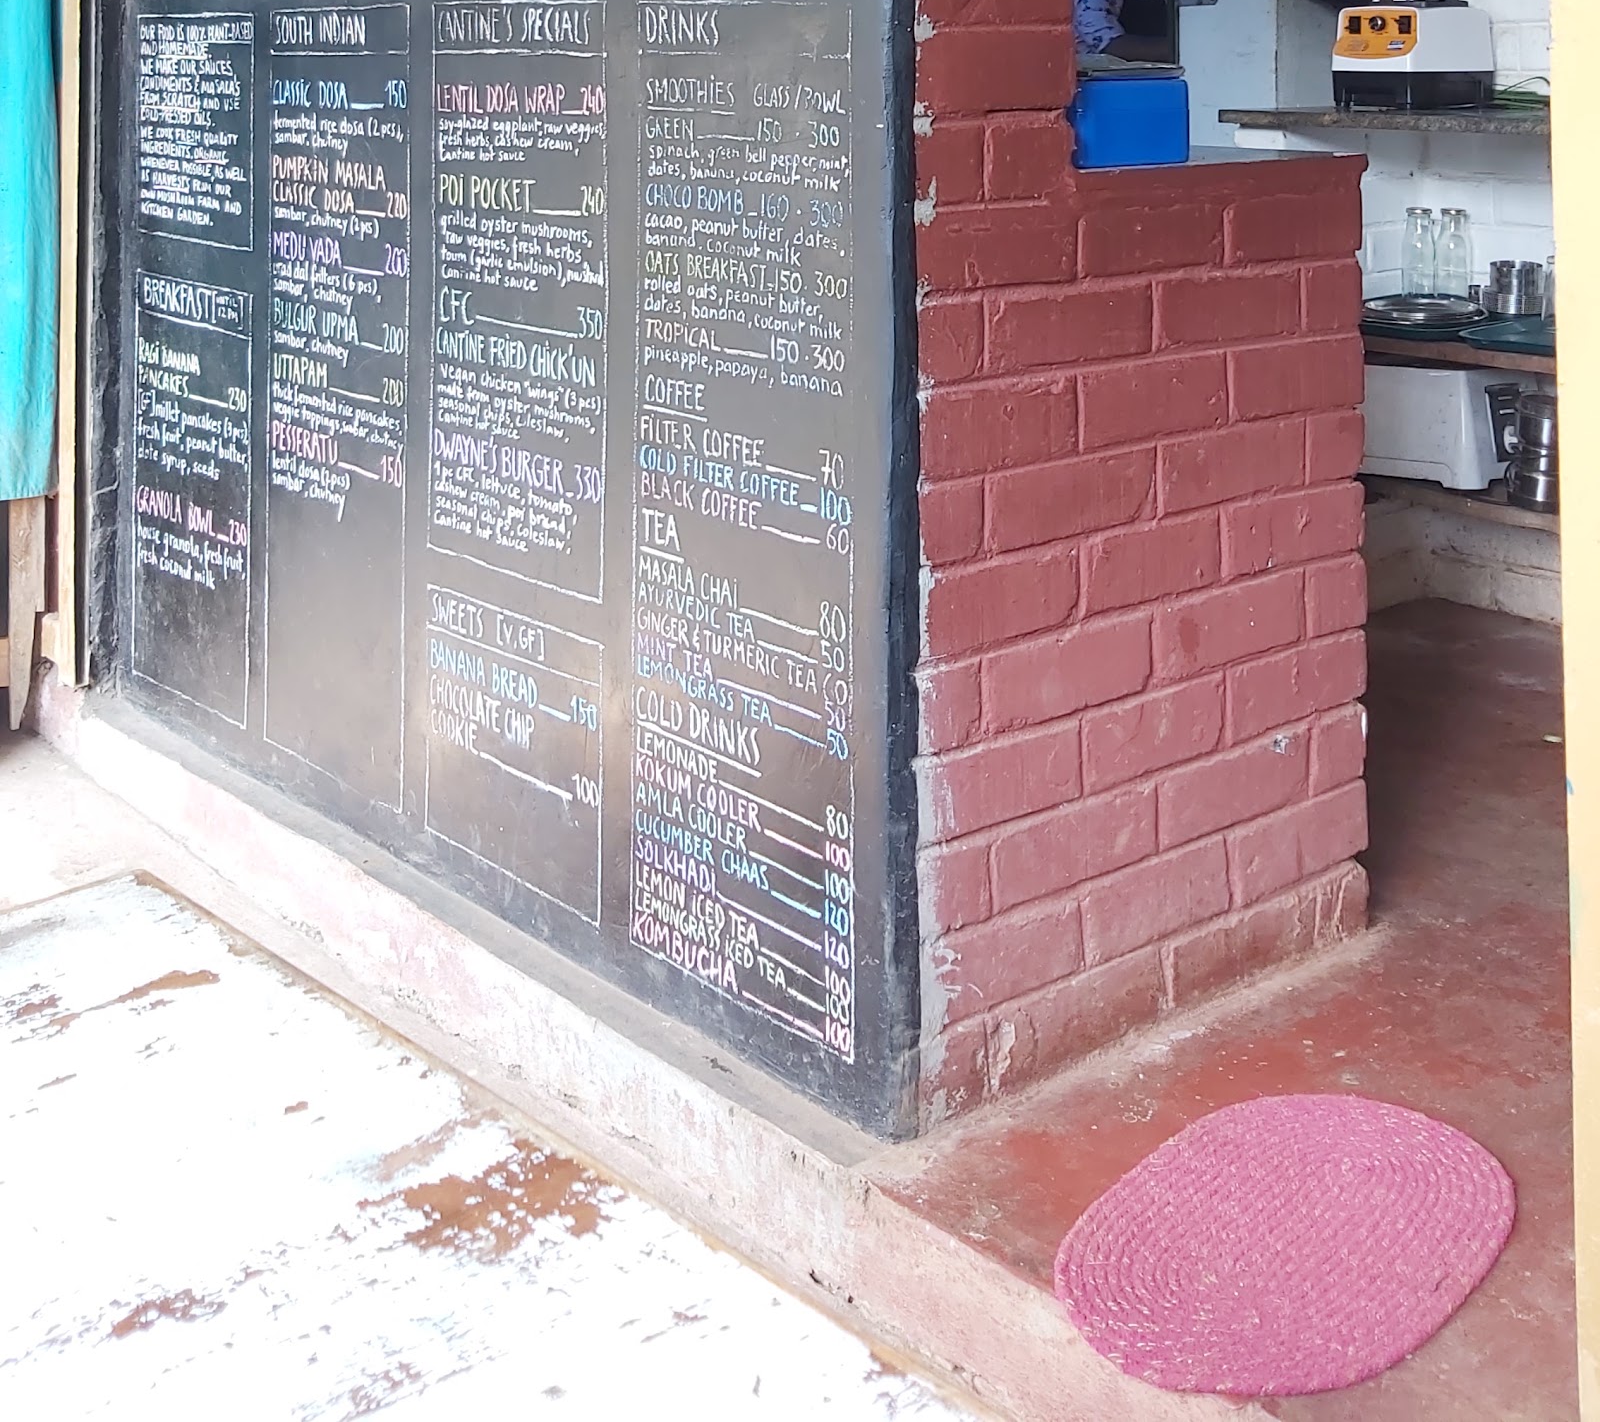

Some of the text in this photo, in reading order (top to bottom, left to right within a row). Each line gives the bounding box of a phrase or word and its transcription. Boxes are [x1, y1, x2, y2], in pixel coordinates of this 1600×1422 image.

[140, 24, 155, 39] OUR
[158, 24, 175, 40] FOOD
[141, 41, 157, 56] AND
[276, 12, 366, 46] SOUTH INDIAN
[521, 7, 591, 45] SPECIALS
[645, 5, 719, 47] DRINKS
[319, 80, 348, 110] DOSA
[385, 80, 406, 108] 150
[486, 82, 519, 113] DOSA
[525, 83, 565, 115] WRAP
[580, 85, 603, 116] 240
[140, 126, 153, 139] WE
[156, 127, 174, 140] COOK
[175, 127, 201, 143] FRESH
[646, 116, 840, 148] GREEN 150 300
[273, 180, 317, 209] CLASSIC
[324, 188, 354, 213] DOSA
[335, 160, 386, 191] MASALA
[471, 176, 536, 213] POCKET
[581, 186, 604, 216] 240
[141, 201, 173, 220] KITCHEN
[441, 210, 477, 235] grilled
[481, 215, 518, 237] oyster
[645, 183, 844, 228] CHOCO BOMB 160 300
[274, 230, 408, 277] MEDU VADA 200
[645, 250, 848, 299] OATS BREAKFAST 150 300
[274, 297, 404, 355] BULGUR UPMA 200
[440, 286, 603, 339] CFC 350
[162, 345, 200, 376] BANANA
[437, 327, 486, 363] CANTINE
[644, 318, 845, 373] TROPICAL 150 300
[139, 365, 247, 412] PANCAKES 230
[274, 353, 404, 407] UTTAPAM 200
[644, 374, 705, 410] COFFEE
[781, 365, 844, 397] banana
[272, 420, 402, 488] PESSERATU 150
[434, 428, 601, 503] DWAYNE'S BURGER 330
[703, 429, 765, 467] COFFEE
[819, 449, 844, 490] 70
[640, 445, 851, 526] COLD FILTER COFFEE 100
[137, 485, 247, 546] GRANOLA BOWL 230
[641, 471, 850, 555] BLACK COFFEE 60
[642, 508, 680, 551] TEA
[137, 540, 216, 589] fresh coconut milk
[432, 593, 483, 637] SWEETS
[639, 555, 847, 643] MASALA CHAI 80
[637, 606, 689, 648] GINGER
[693, 622, 700, 652] &
[703, 630, 780, 679] TURMERIC
[786, 660, 818, 695] TEA
[639, 582, 845, 672] AYURVEDIC TEA 50
[431, 638, 597, 731] BANANA BREAD 150
[637, 632, 846, 732] MINT TEA 50
[430, 675, 535, 750] CHOCOLATE CHIP
[636, 686, 760, 765] COLD DRINKS
[637, 654, 849, 761] LEMONGRASS TEA 50
[431, 709, 599, 808] COOKIE 100
[636, 726, 849, 839] LEMONADE 80
[636, 753, 850, 872] KOKUM COOLER 100
[636, 782, 849, 904] AMLA COOLER 100
[636, 809, 849, 936] CUCUMBER CHAAS 120
[825, 930, 849, 969] 120
[633, 911, 850, 1052] KOMBUCHA 100
